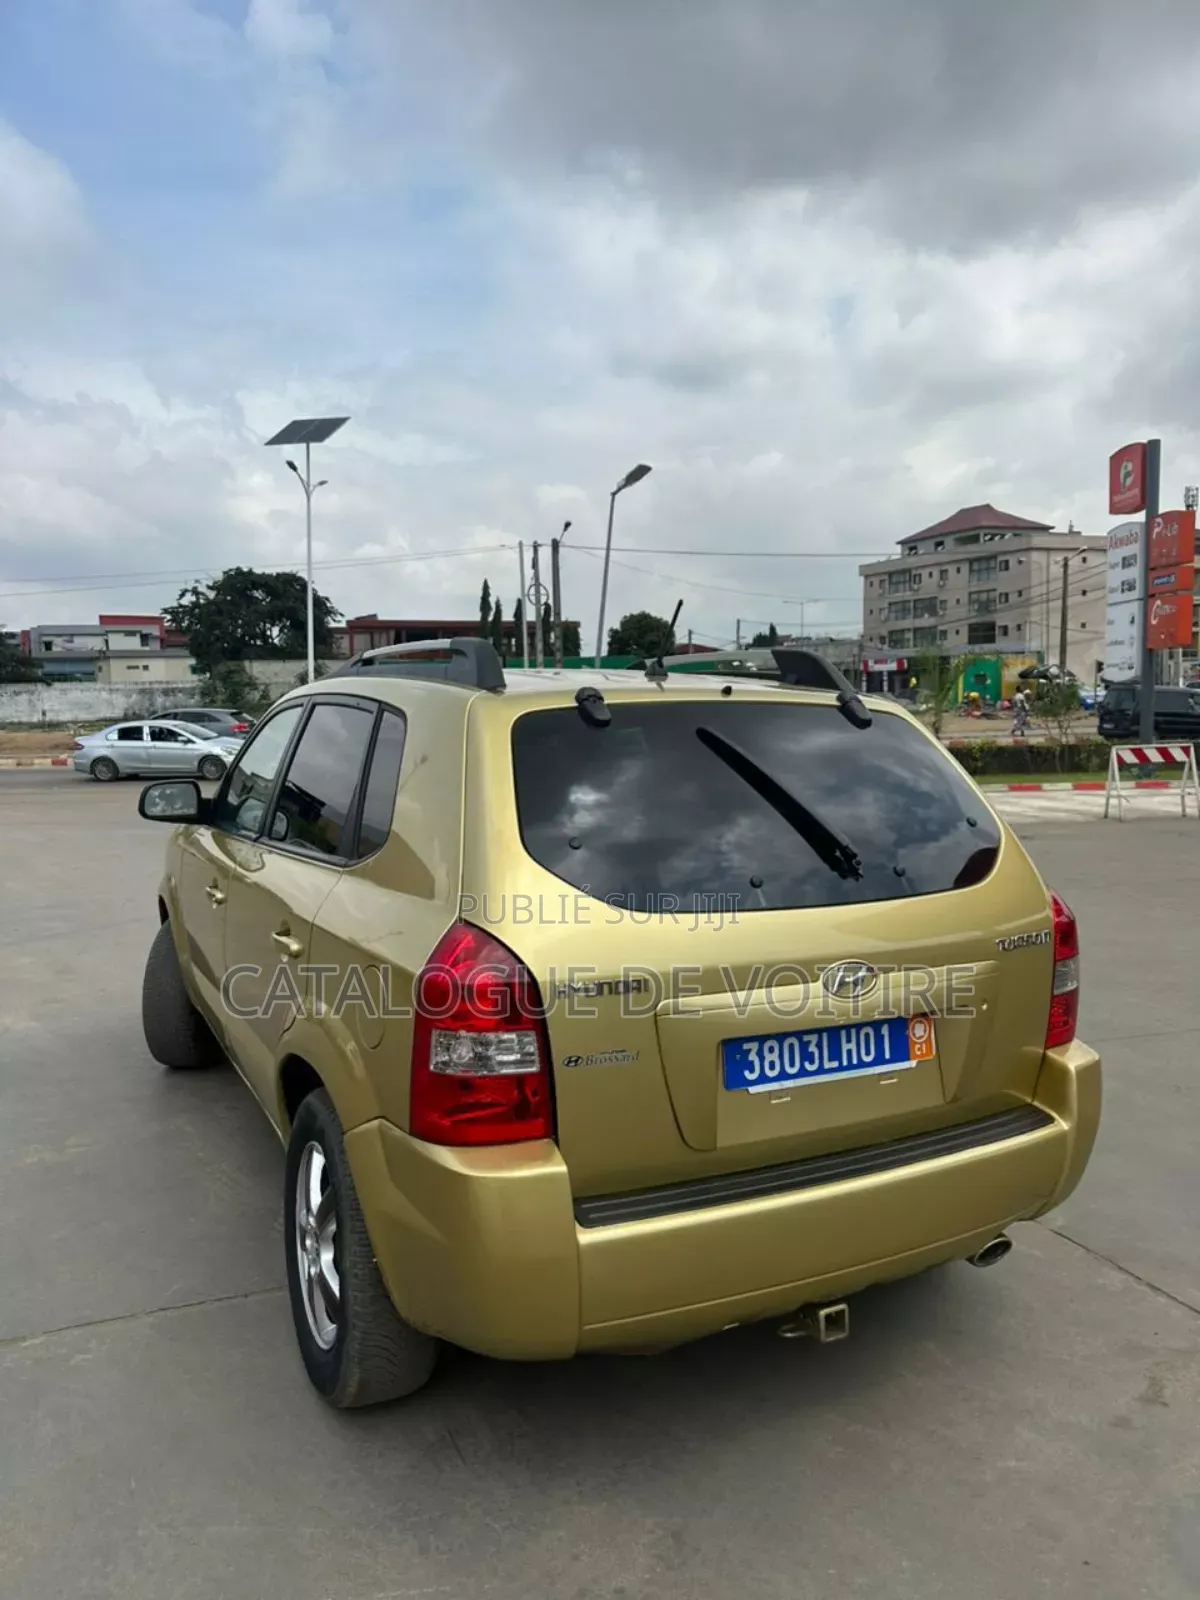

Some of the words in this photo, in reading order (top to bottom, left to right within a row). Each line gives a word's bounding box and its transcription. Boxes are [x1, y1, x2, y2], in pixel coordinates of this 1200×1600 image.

[554, 978, 650, 999] HYUNDAI
[742, 1023, 891, 1081] 3803LH01
[914, 1042, 926, 1055] CI
[586, 1050, 640, 1067] Brossard
